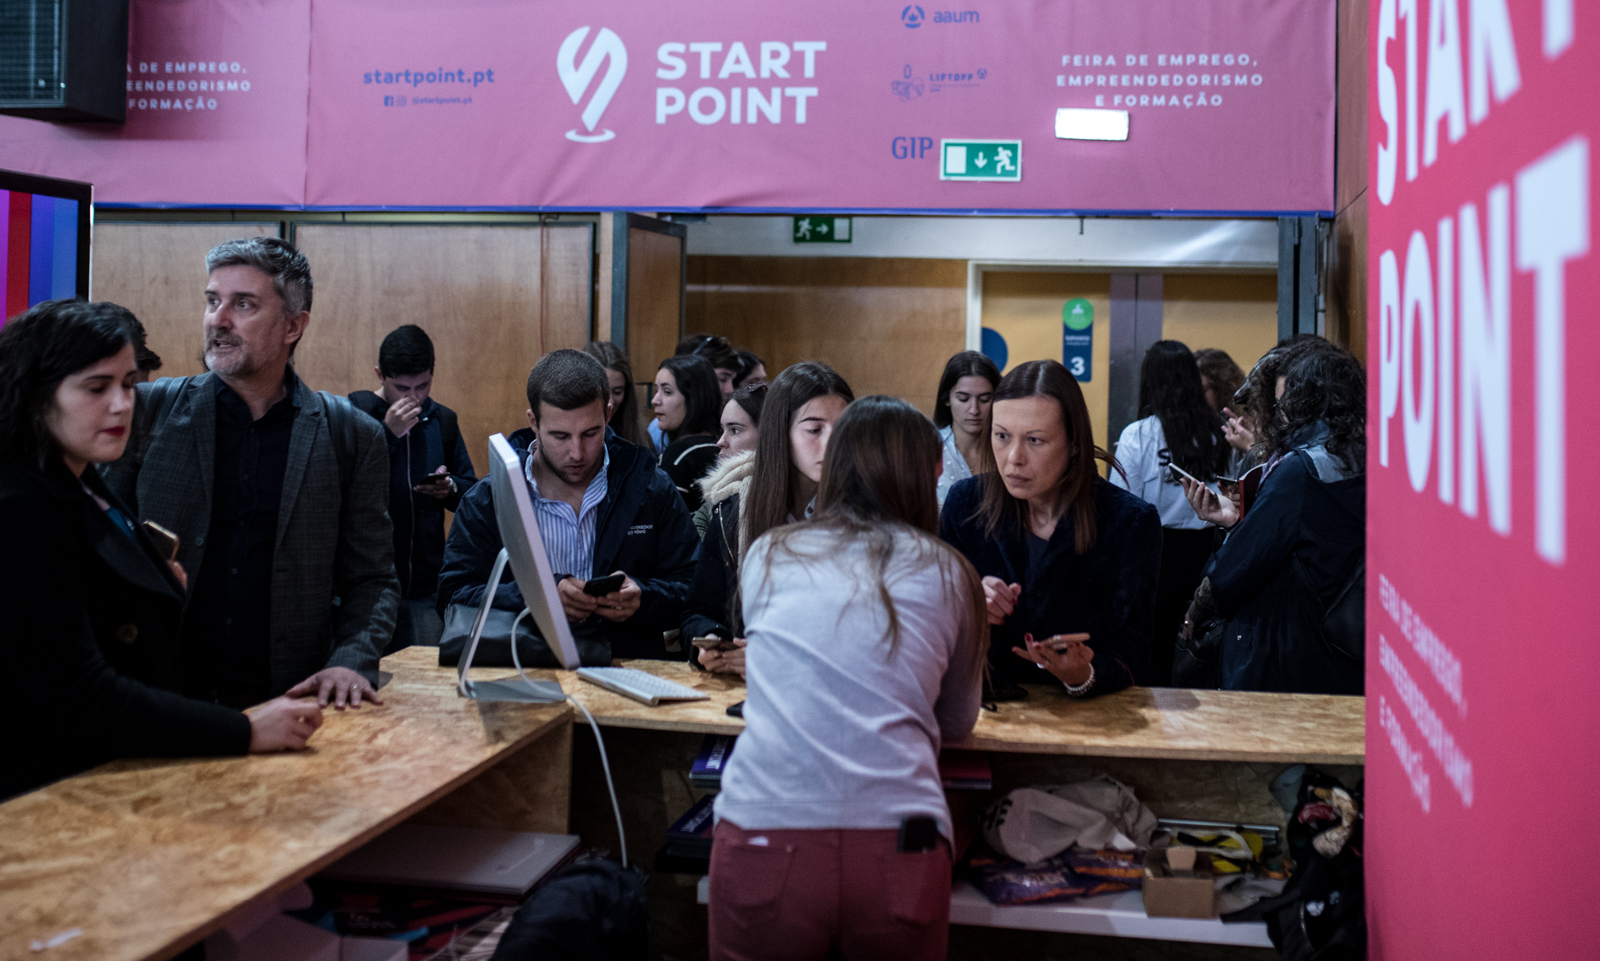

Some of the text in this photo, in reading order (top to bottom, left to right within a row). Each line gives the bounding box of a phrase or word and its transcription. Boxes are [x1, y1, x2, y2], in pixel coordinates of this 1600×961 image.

[933, 11, 980, 23] aaum
[139, 62, 158, 73] DE
[165, 61, 246, 74] EMPREGO,
[656, 41, 827, 80] START
[1061, 53, 1258, 67] FEIRA DE EMPREGO,
[363, 67, 495, 88] startpoint.pt
[929, 73, 974, 81] LIFTOFF
[1056, 74, 1263, 87] EMPREENDEDORISMO
[126, 80, 250, 92] EENDEDORISMO
[128, 96, 217, 111] FORMAÇÃO
[655, 87, 819, 125] POINT
[1095, 92, 1223, 109] E FORMAÇÃO
[1377, 0, 1574, 206] STA
[891, 136, 934, 159] GIP
[1379, 134, 1590, 565] POINT
[1070, 356, 1086, 376] 3
